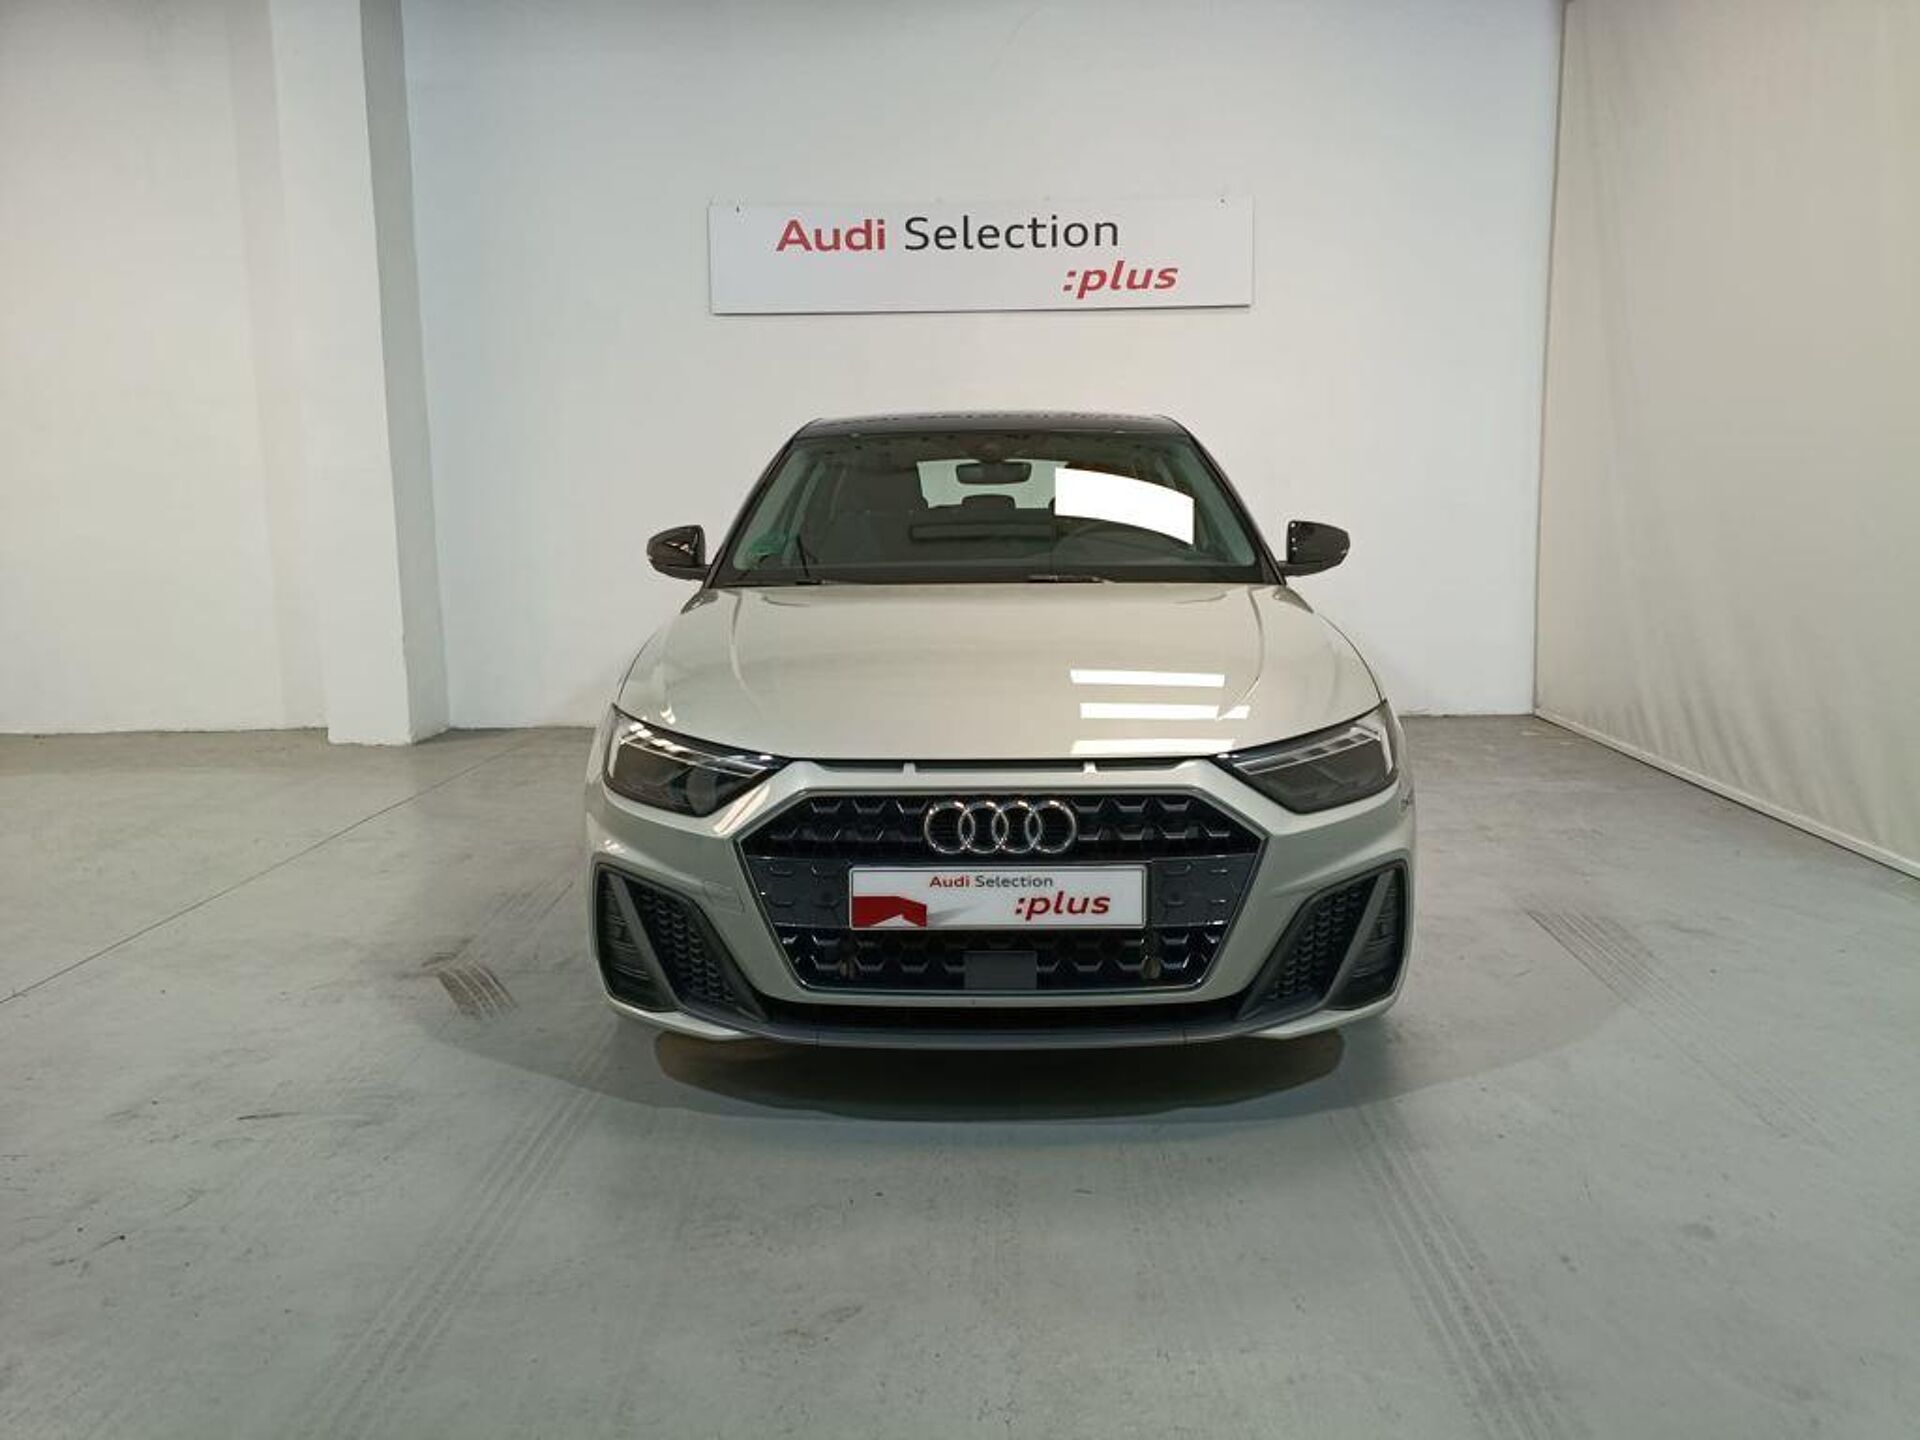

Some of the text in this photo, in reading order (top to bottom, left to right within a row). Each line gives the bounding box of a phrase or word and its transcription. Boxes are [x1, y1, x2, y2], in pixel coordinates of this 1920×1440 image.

[776, 215, 1119, 251] Audi Selection
[1062, 260, 1178, 299] :plus
[929, 875, 1053, 888] Audi Selection
[1015, 891, 1111, 920] :plus
